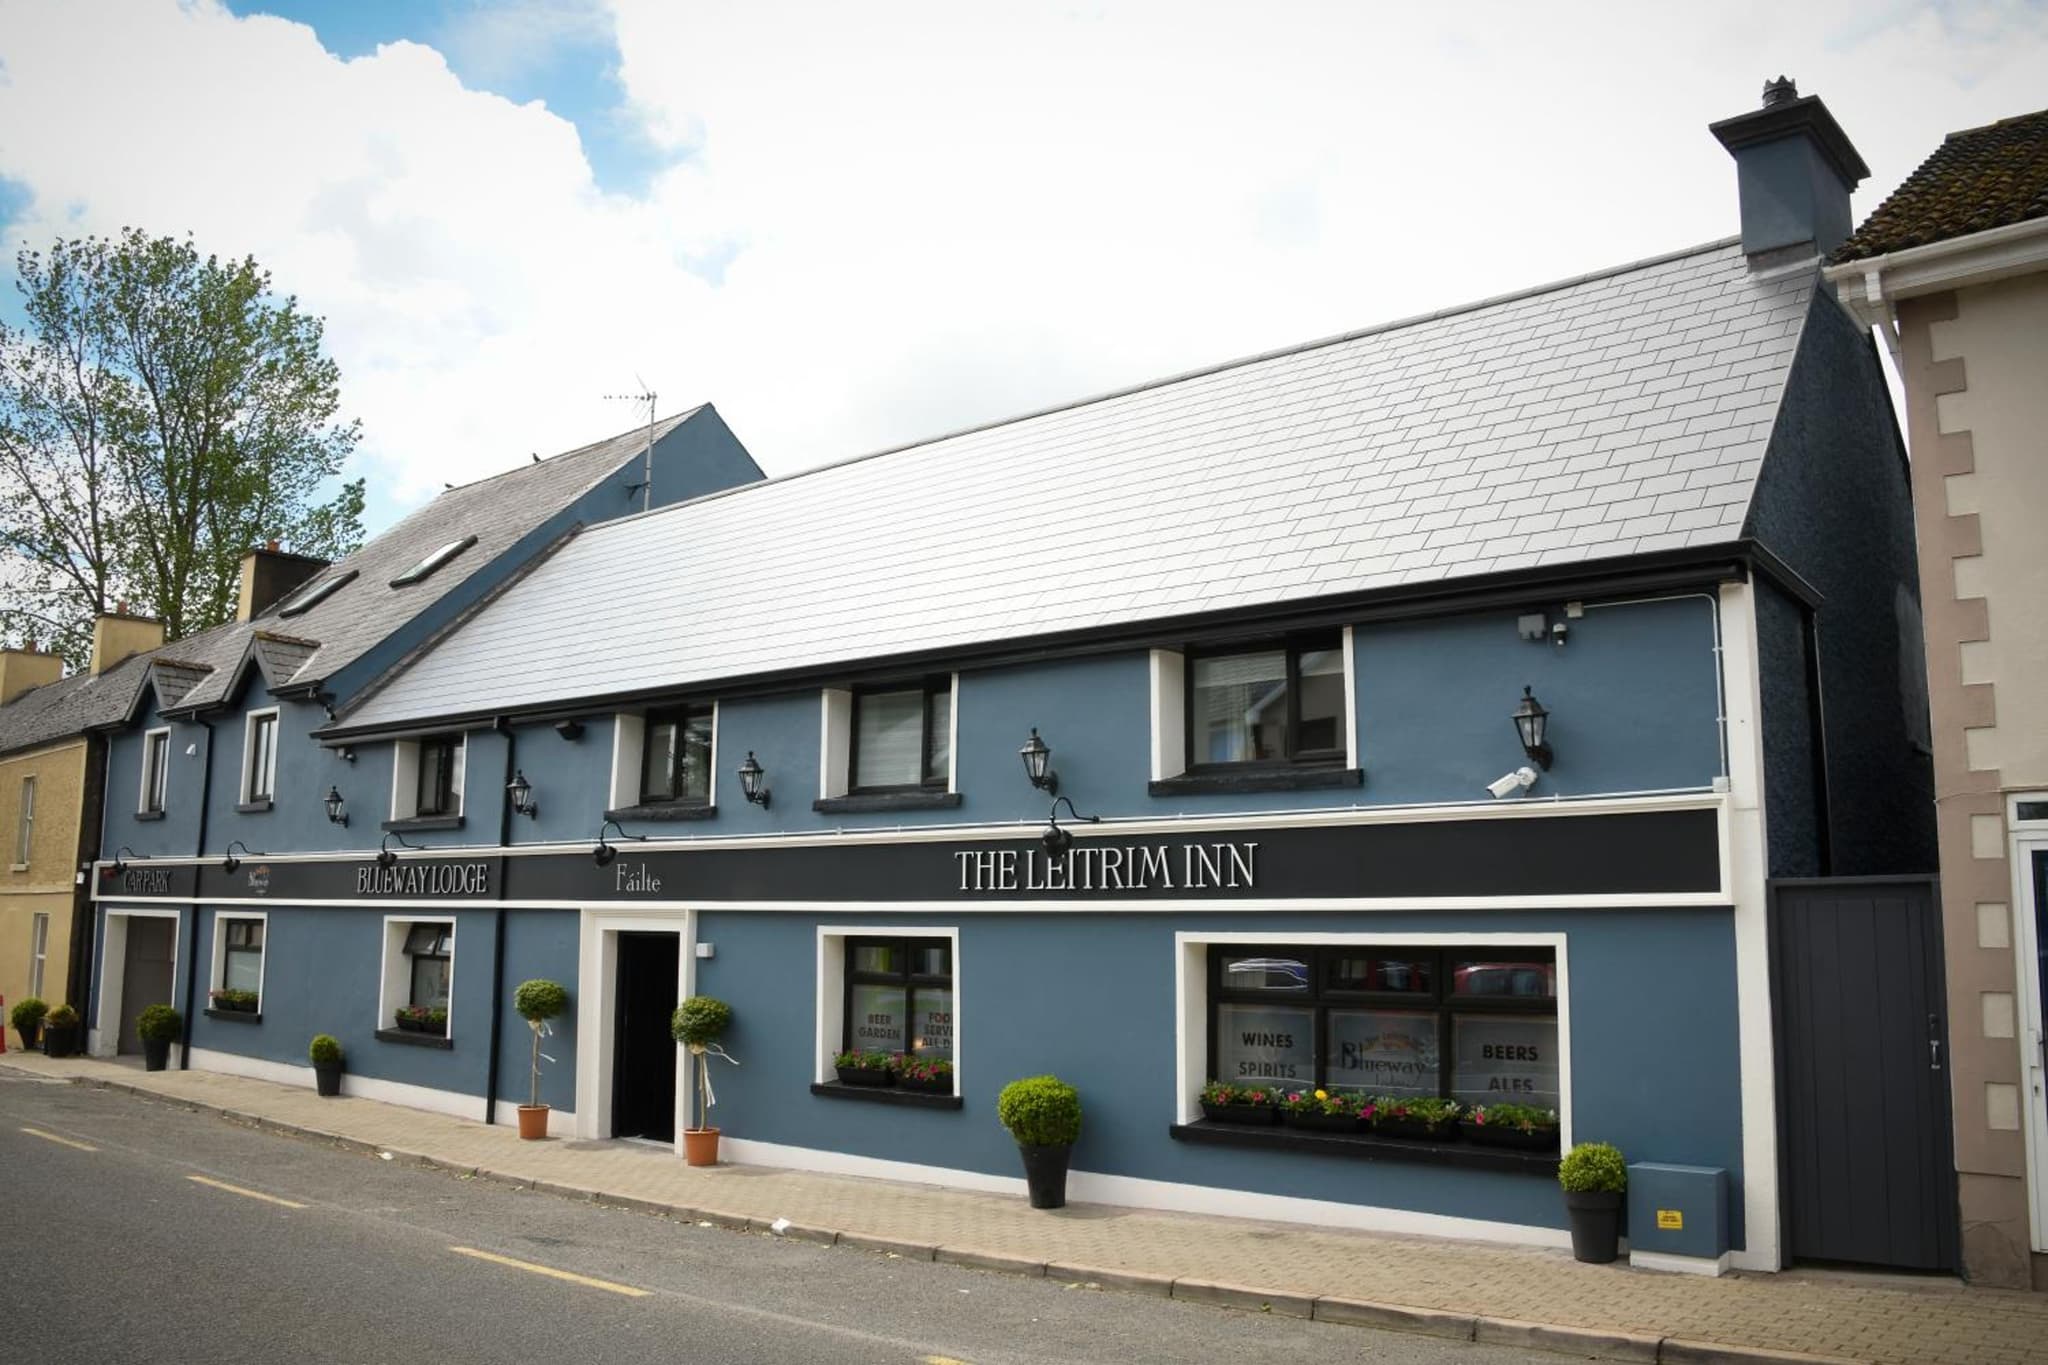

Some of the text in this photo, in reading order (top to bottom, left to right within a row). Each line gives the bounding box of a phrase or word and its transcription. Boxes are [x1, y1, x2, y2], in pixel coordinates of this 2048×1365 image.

[954, 843, 1259, 890] THE LEITRIM INN
[357, 864, 487, 894] BLUEWAY LODGE
[616, 863, 661, 893] Fáilte
[868, 1014, 891, 1025] BEER
[928, 1012, 952, 1024] FOO
[858, 1026, 901, 1040] GARDEN
[924, 1024, 953, 1037] SERV
[1242, 1031, 1294, 1049] WINES
[1341, 1039, 1427, 1081] Blueway
[1483, 1044, 1539, 1061] BEERS
[1239, 1060, 1297, 1078] SPIRITS
[1488, 1075, 1533, 1094] ALES
